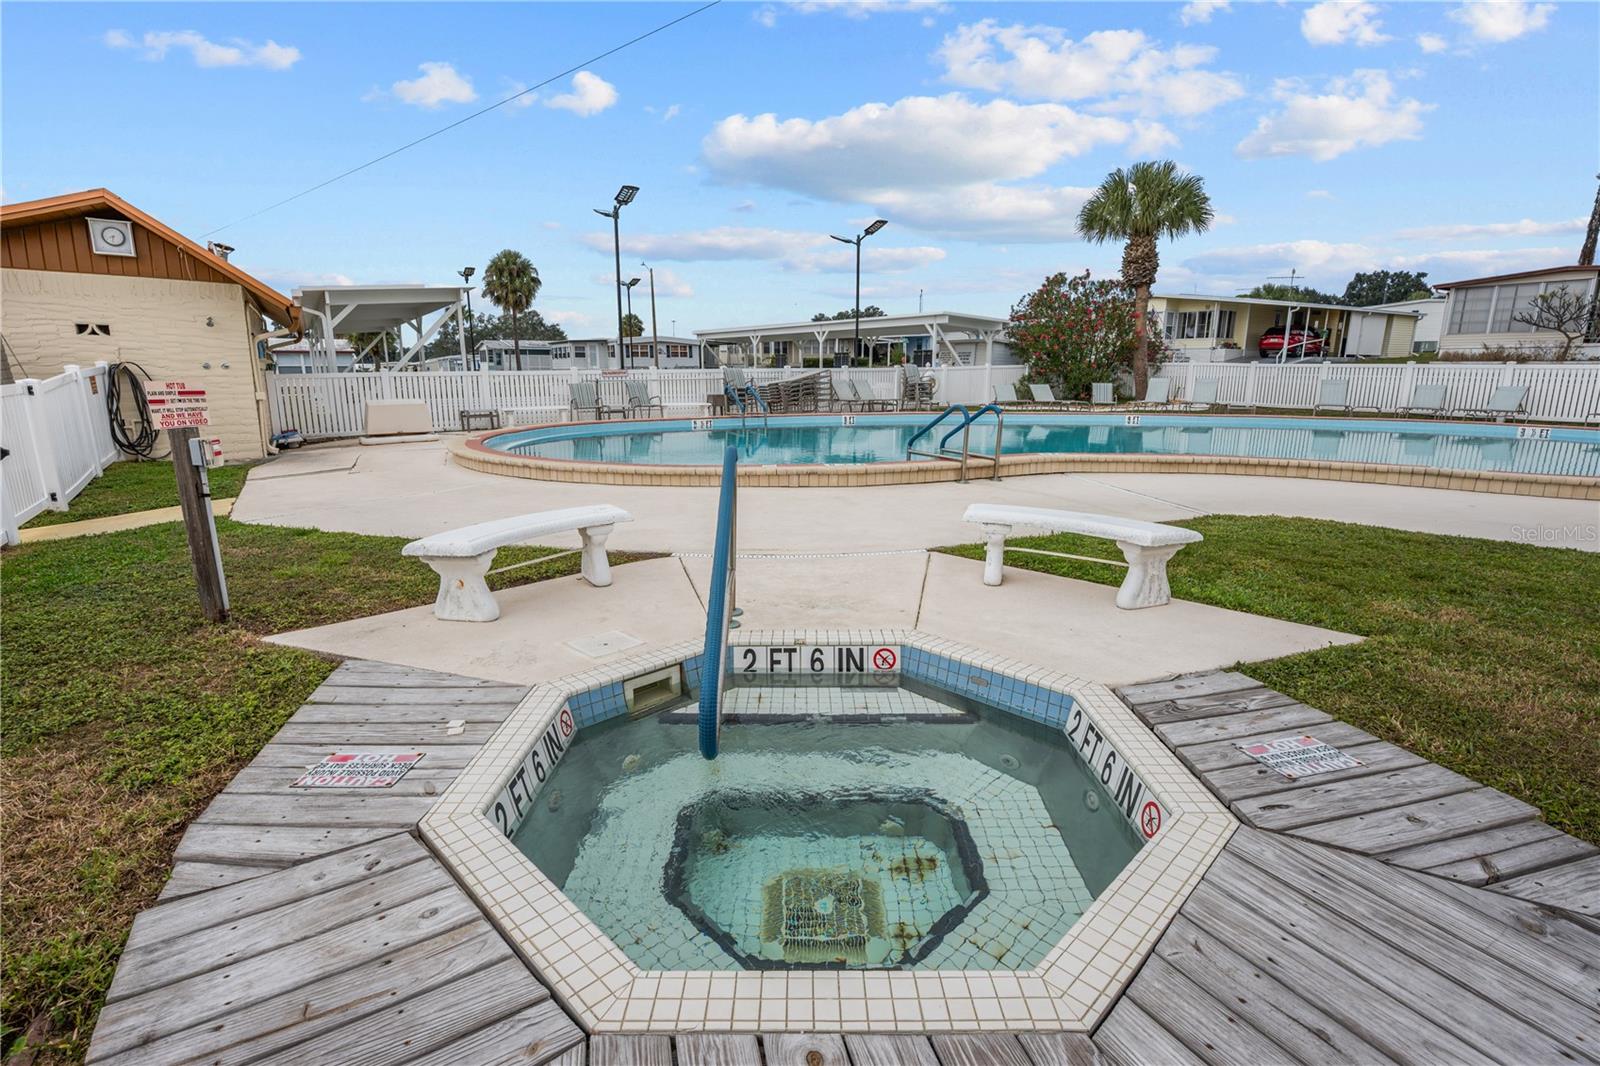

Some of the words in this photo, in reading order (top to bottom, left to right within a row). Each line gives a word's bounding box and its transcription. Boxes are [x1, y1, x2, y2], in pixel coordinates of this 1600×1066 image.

[743, 648, 757, 672] 2
[770, 648, 797, 672] FT
[810, 648, 824, 672] 6
[838, 648, 864, 672] IN
[494, 801, 514, 838] 2
[508, 766, 532, 818] FT
[532, 750, 546, 783] 6
[543, 723, 564, 766] IN
[1067, 710, 1082, 742] 2
[1080, 723, 1104, 765] FT
[1101, 750, 1116, 785] 6
[1114, 766, 1142, 819] IN
